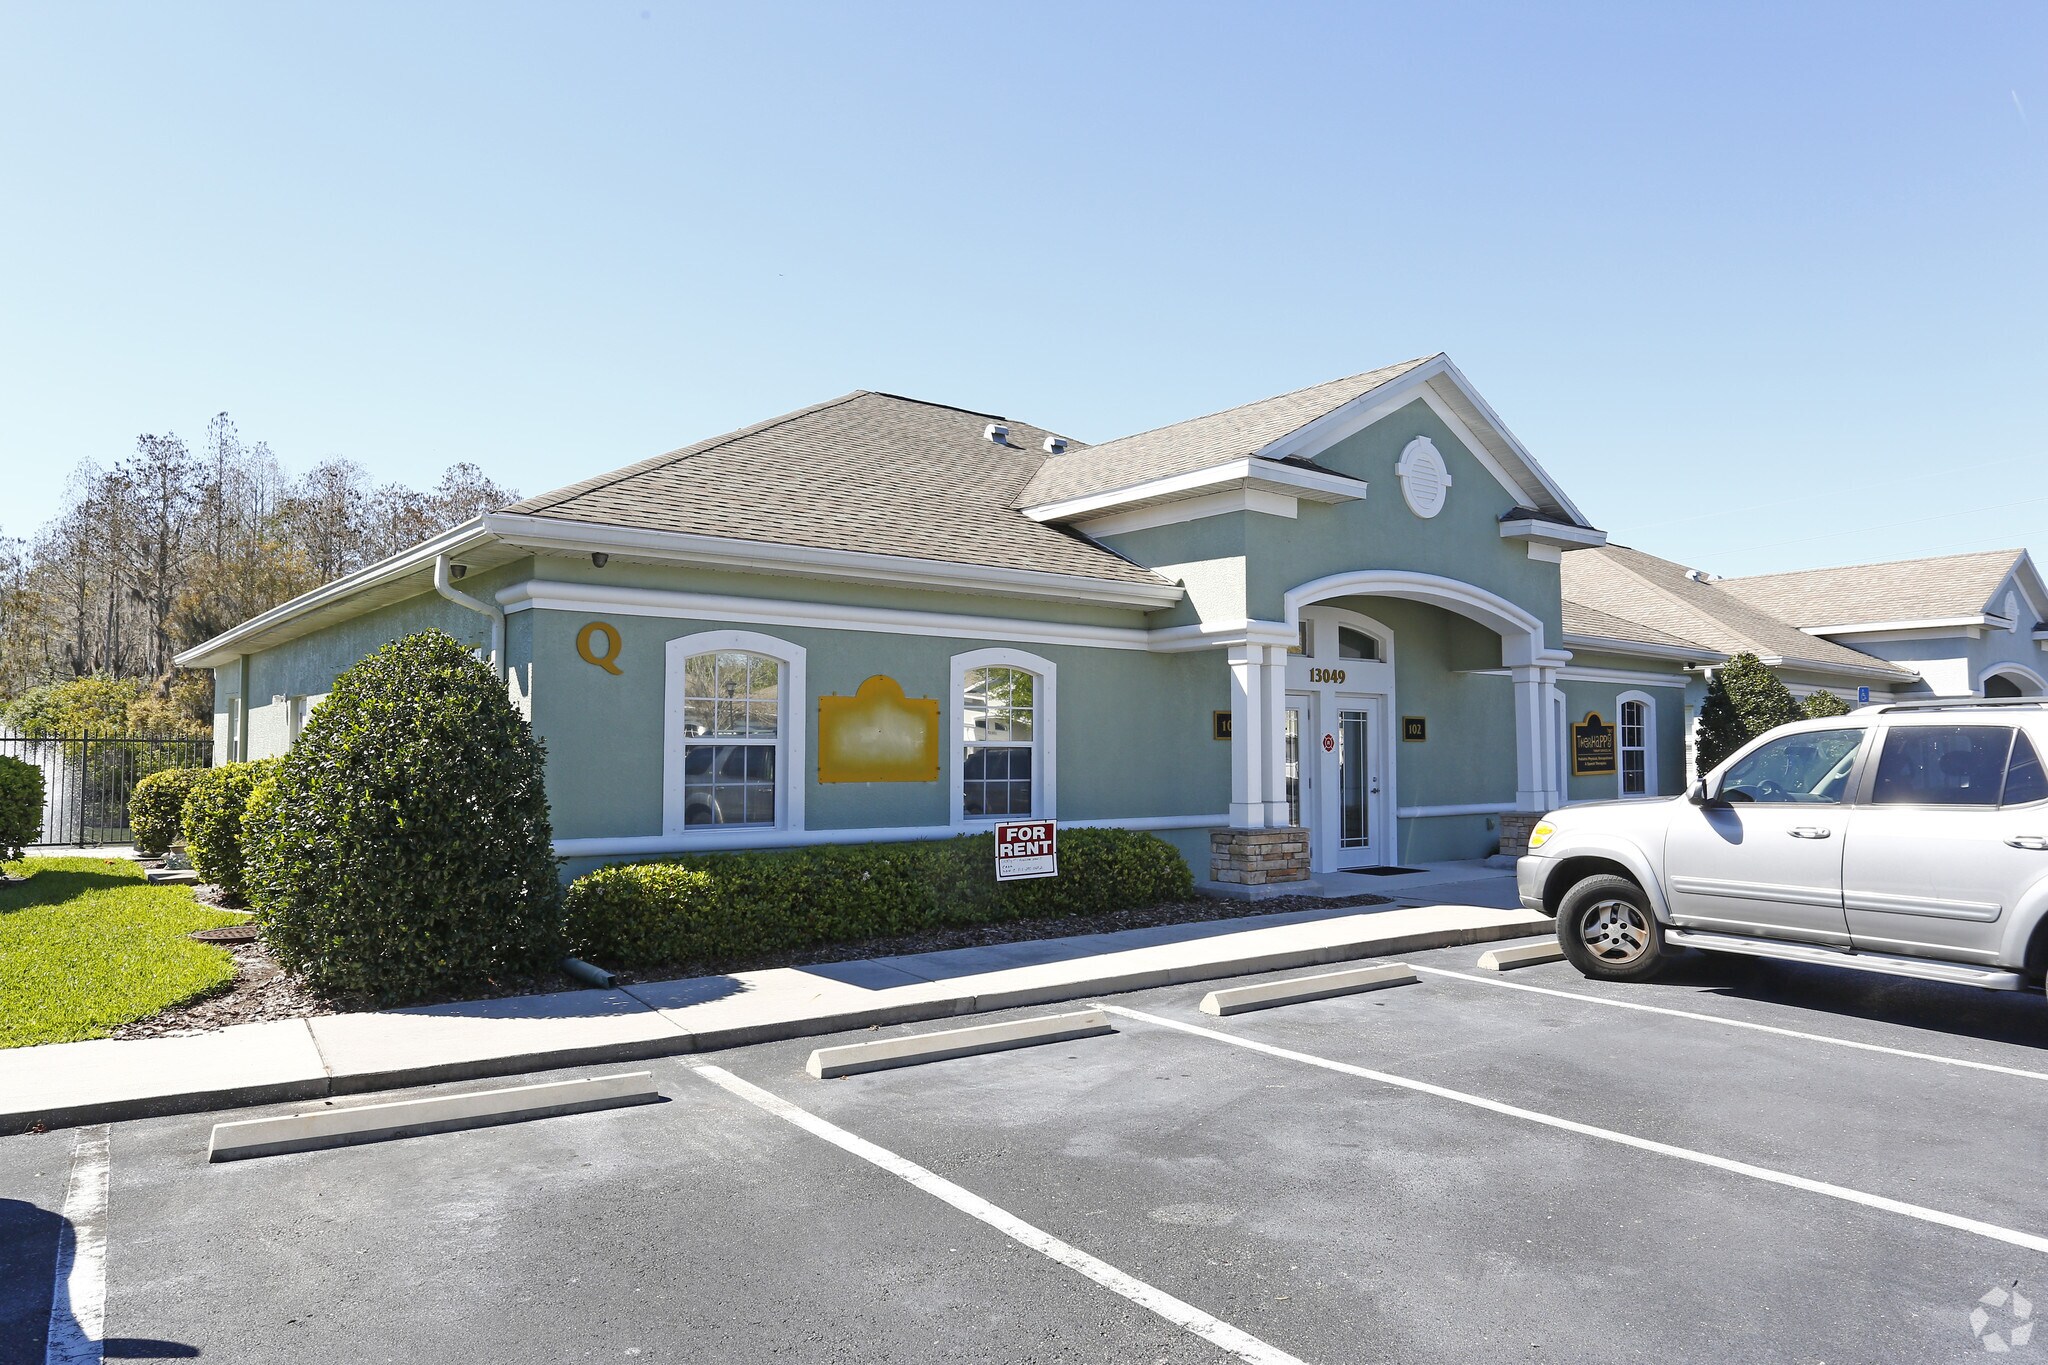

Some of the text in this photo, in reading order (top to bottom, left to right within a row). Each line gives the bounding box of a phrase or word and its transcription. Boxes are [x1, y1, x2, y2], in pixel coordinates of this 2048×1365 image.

[576, 621, 624, 676] Q
[1309, 667, 1346, 685] 13049
[1221, 720, 1232, 732] 10
[1408, 724, 1422, 735] 102
[1006, 826, 1046, 842] FOR
[1000, 840, 1052, 857] RENT
